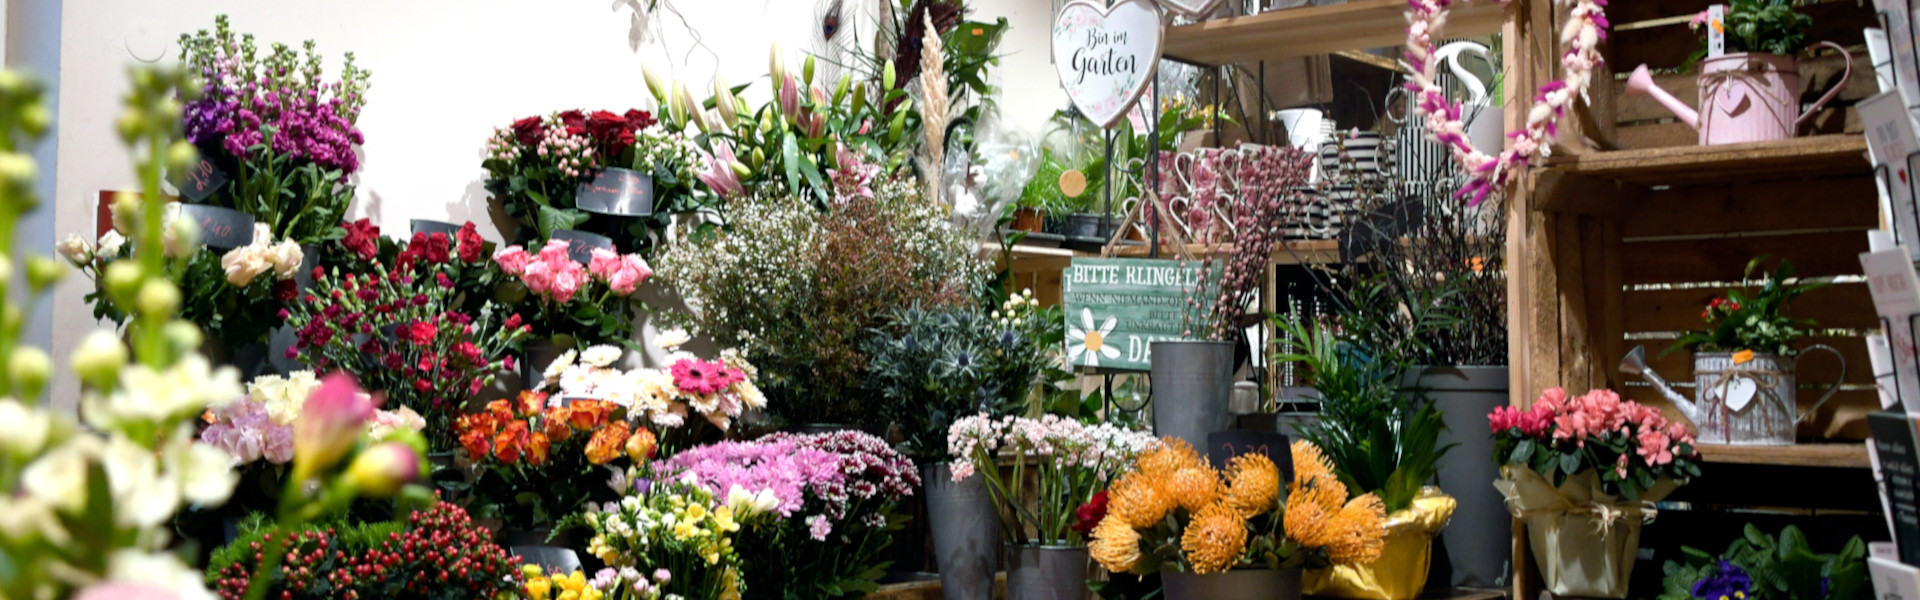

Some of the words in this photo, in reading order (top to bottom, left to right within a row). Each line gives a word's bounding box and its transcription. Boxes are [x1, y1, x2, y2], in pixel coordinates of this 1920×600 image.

[1086, 27, 1109, 50] Bin
[1113, 30, 1128, 45] im
[1071, 47, 1138, 85] Garten
[1073, 264, 1120, 284] BITTE
[1074, 292, 1105, 303] WENN
[1111, 294, 1163, 306] NIEMAND
[1149, 310, 1178, 320] BITTE
[1126, 321, 1175, 332] UNKRAUT
